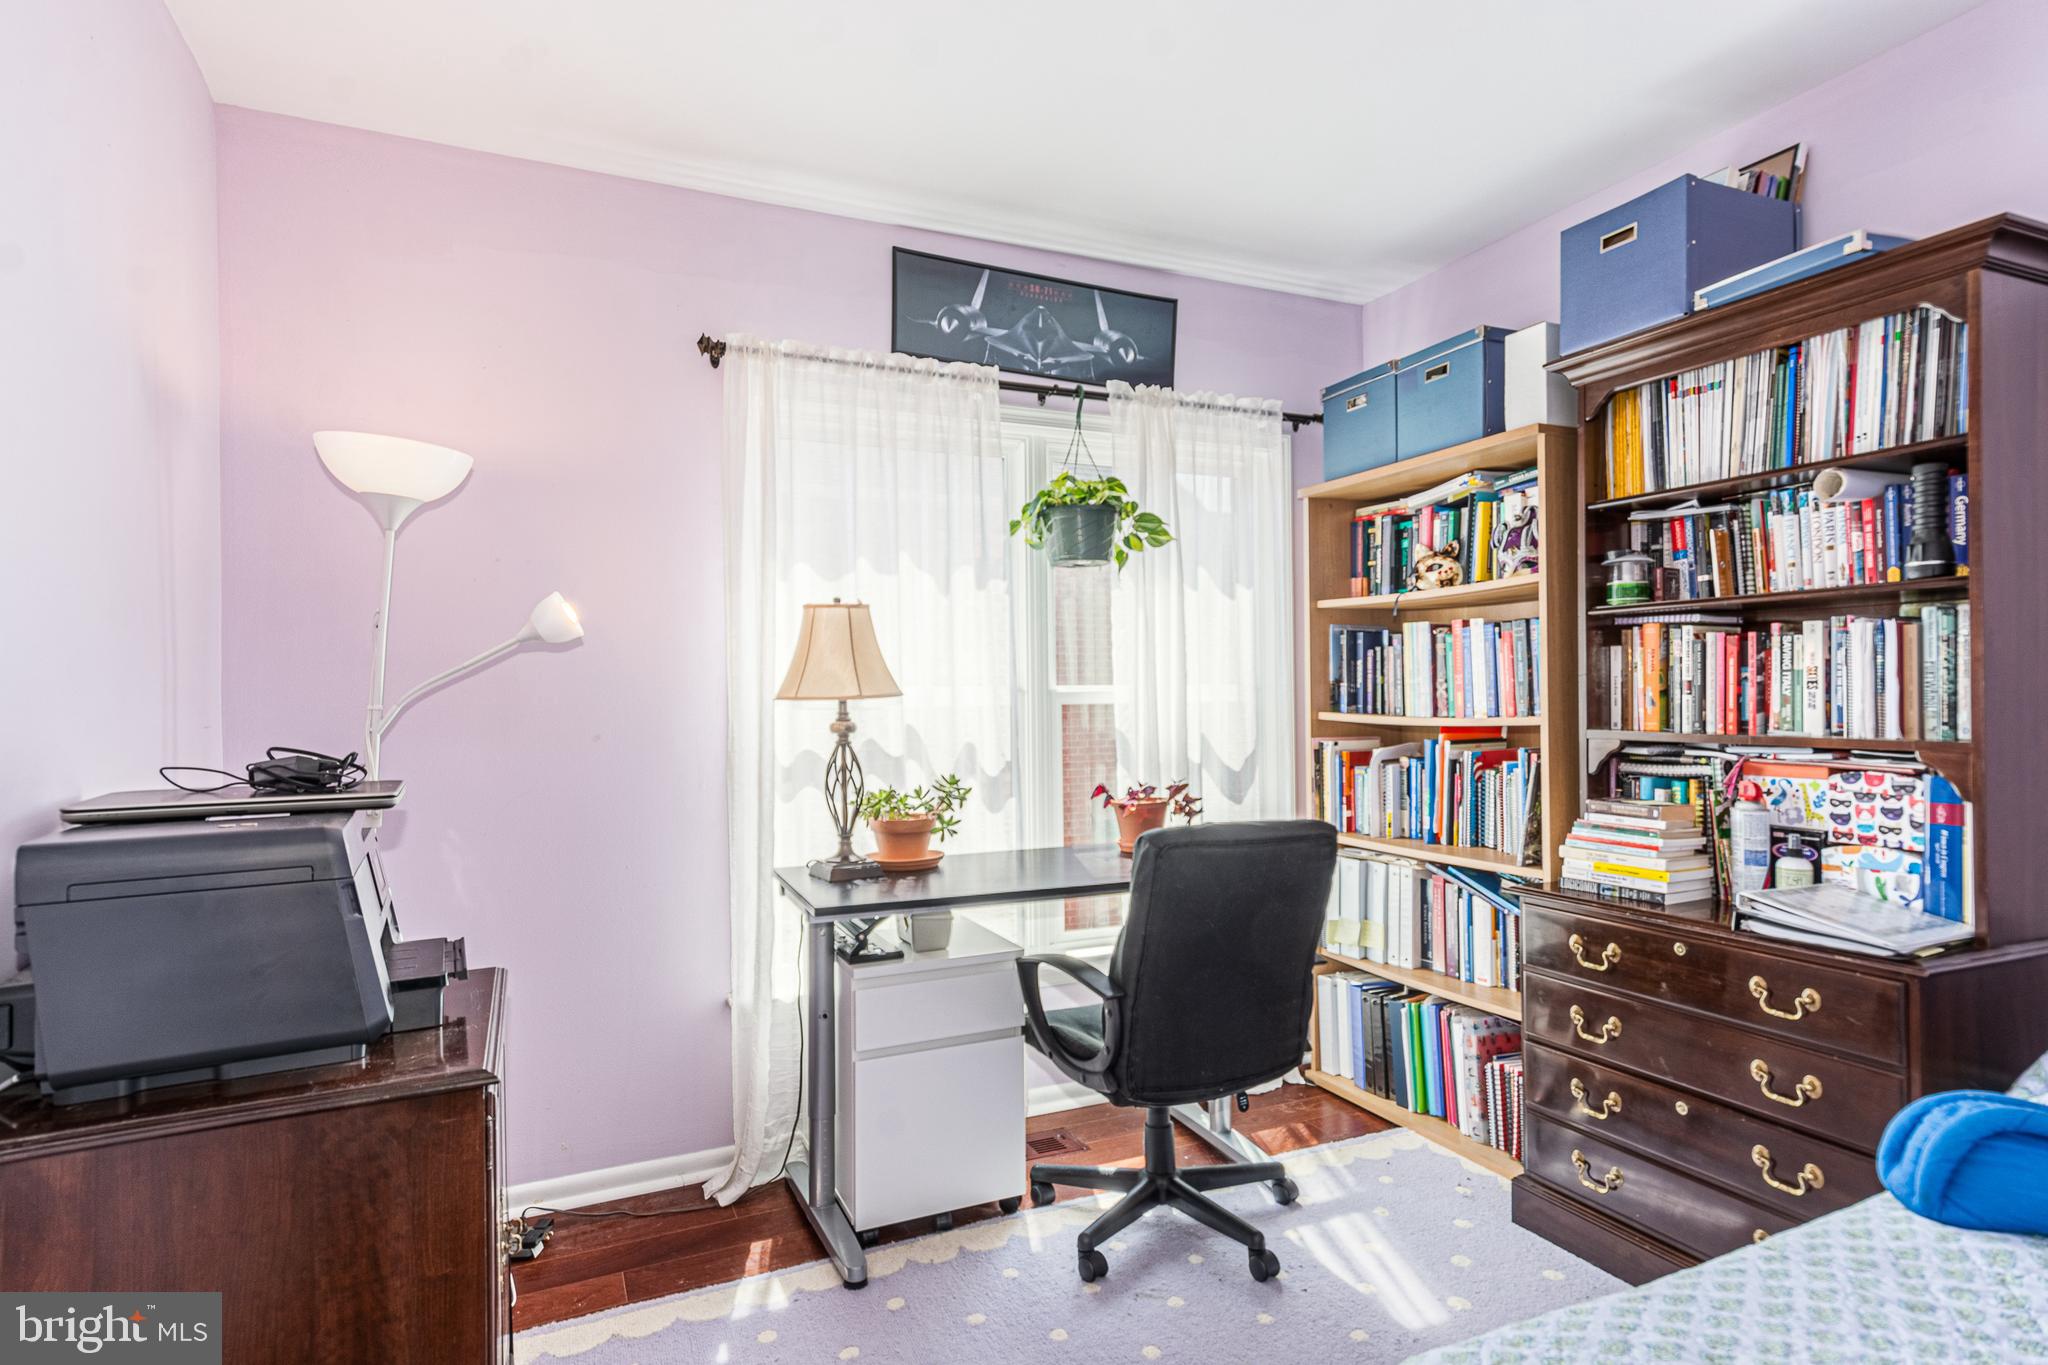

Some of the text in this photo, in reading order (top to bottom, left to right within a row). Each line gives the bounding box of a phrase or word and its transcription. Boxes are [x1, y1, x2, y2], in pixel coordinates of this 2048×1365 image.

[1824, 511, 1835, 544] PARIS
[1952, 495, 1969, 546] Germany
[1812, 513, 1823, 564] LONDON
[1782, 635, 1792, 670] SAVING
[1782, 671, 1792, 696] ITALY
